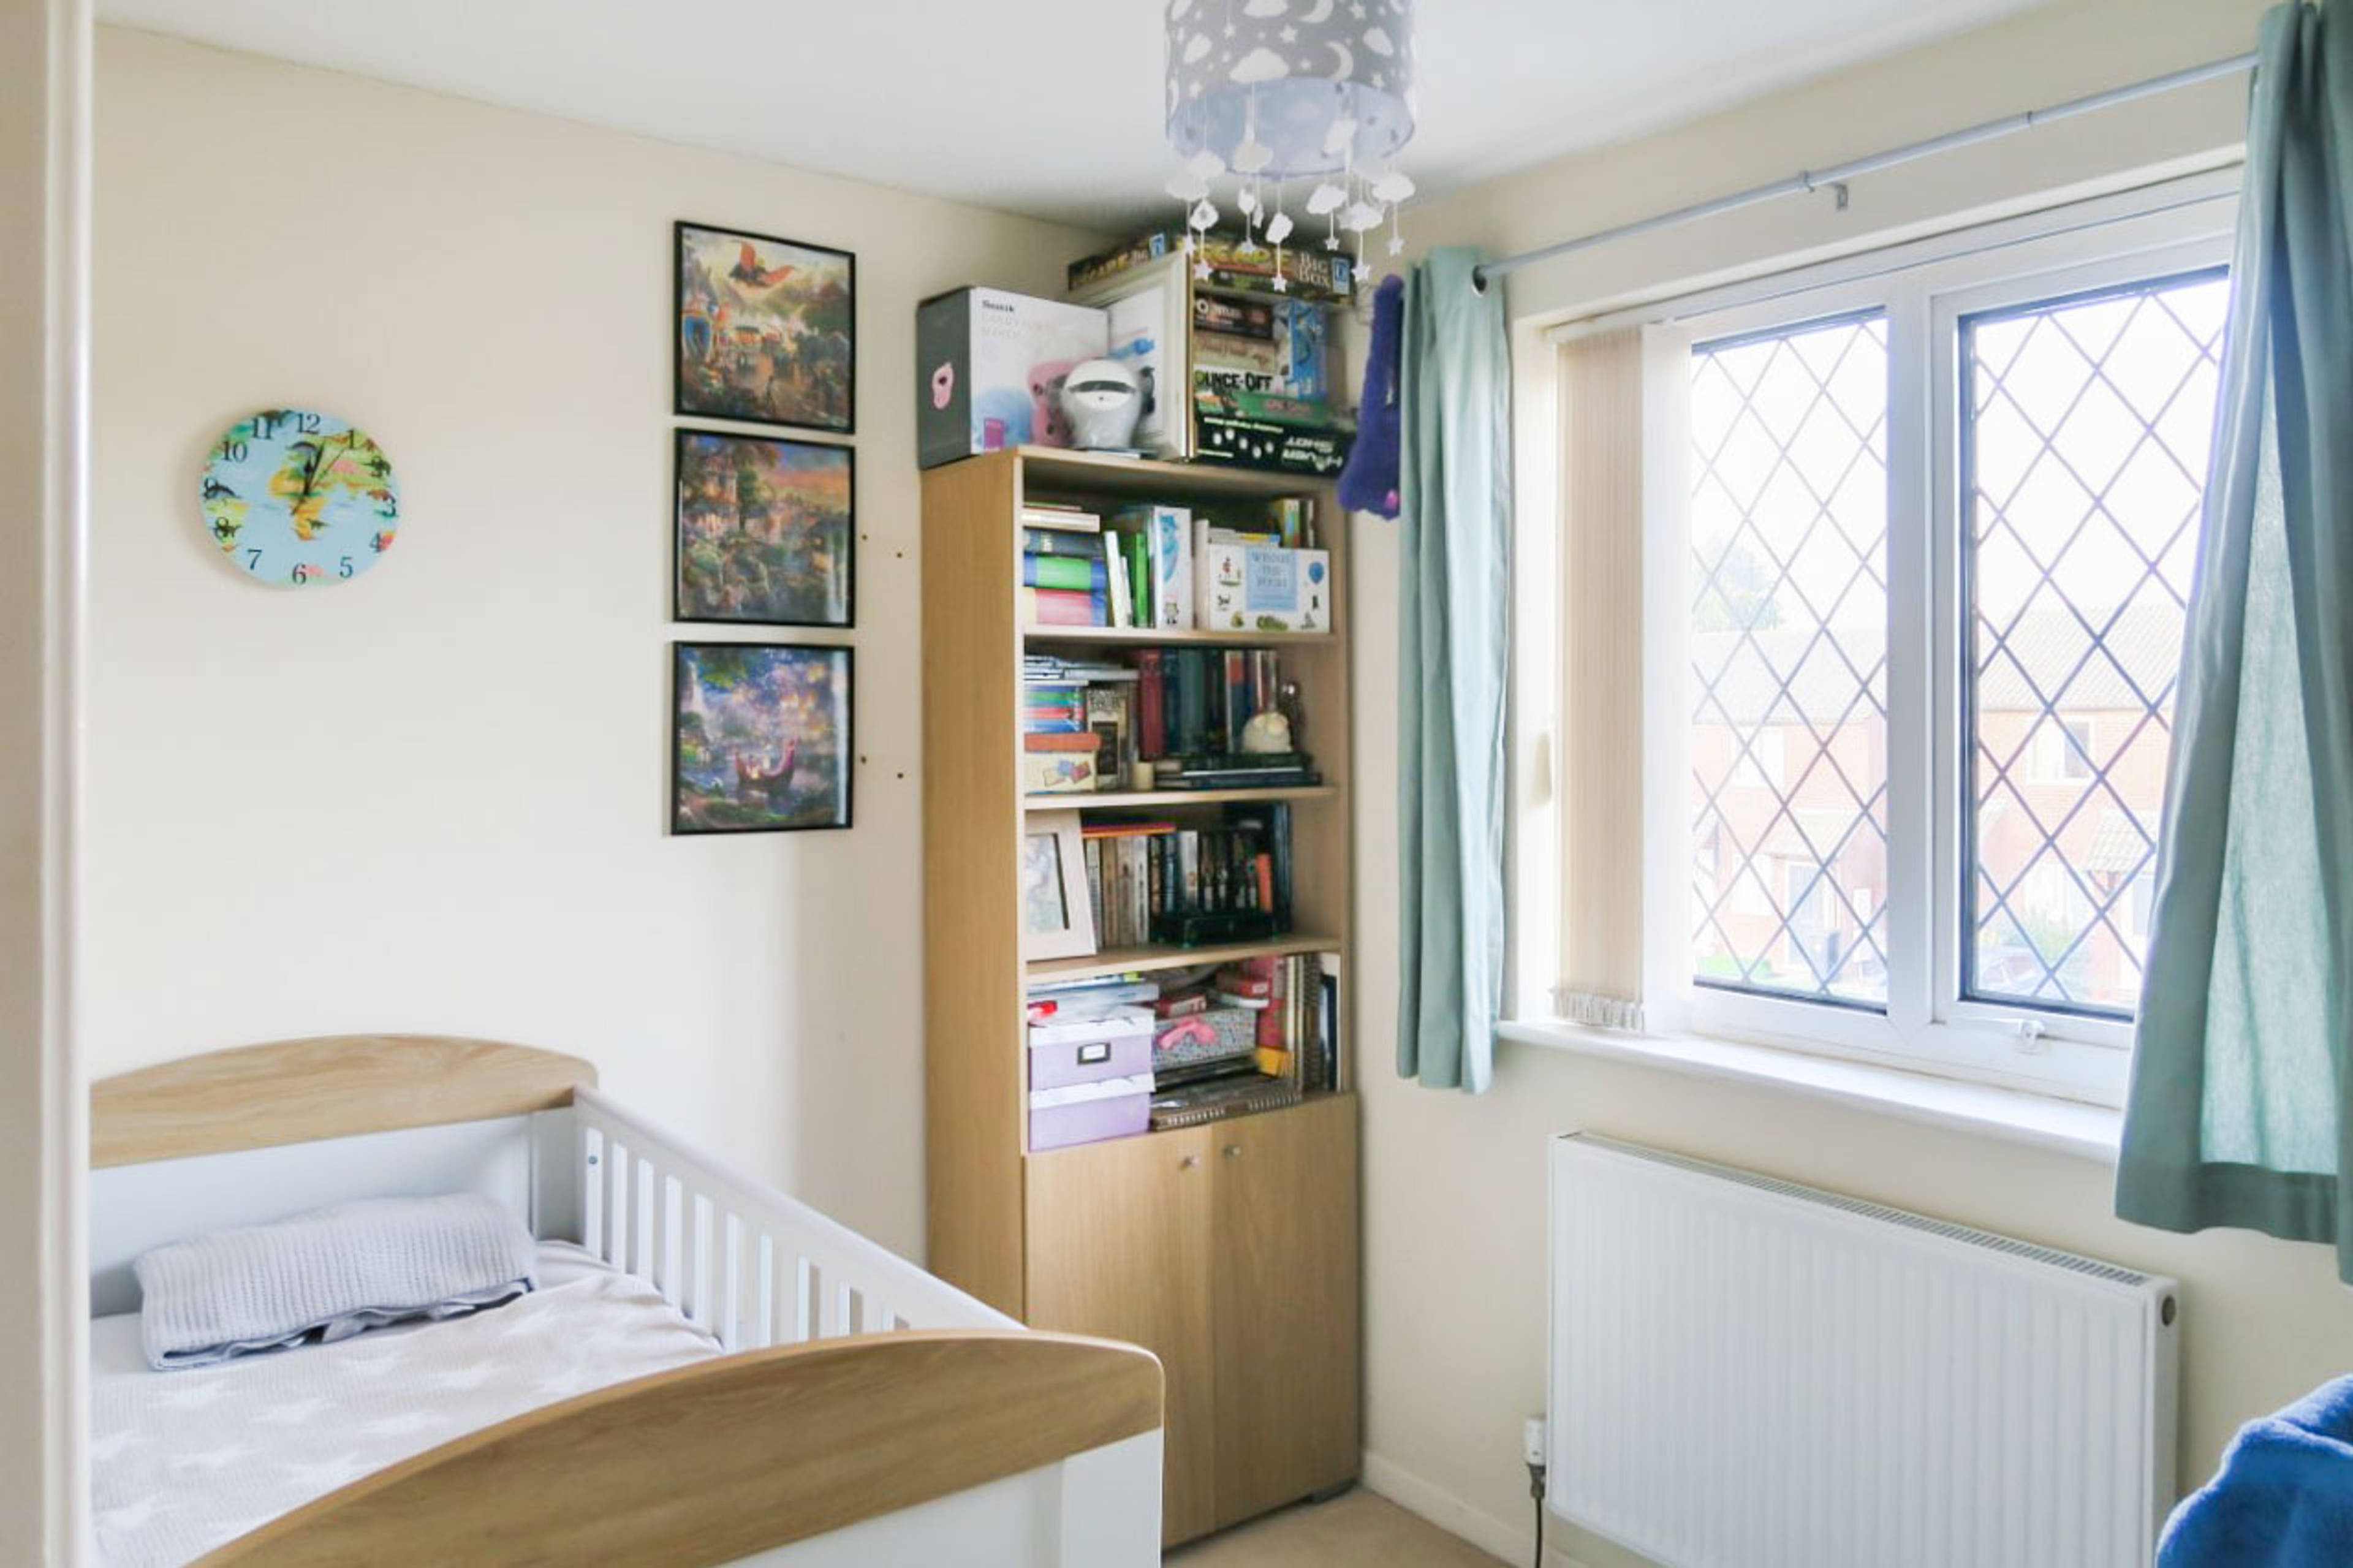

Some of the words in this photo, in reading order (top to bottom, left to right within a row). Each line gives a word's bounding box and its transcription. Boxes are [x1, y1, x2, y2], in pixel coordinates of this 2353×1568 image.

[1300, 252, 1328, 273] BIG
[1299, 265, 1332, 288] BOX
[1194, 369, 1273, 392] OUNCE-OFF
[251, 417, 275, 441] 11
[295, 412, 320, 436] 12
[347, 429, 355, 450] 1
[221, 440, 248, 463] 10
[369, 531, 383, 553] 4
[246, 548, 263, 570] 7
[339, 556, 354, 578] 5
[292, 562, 306, 585] 6
